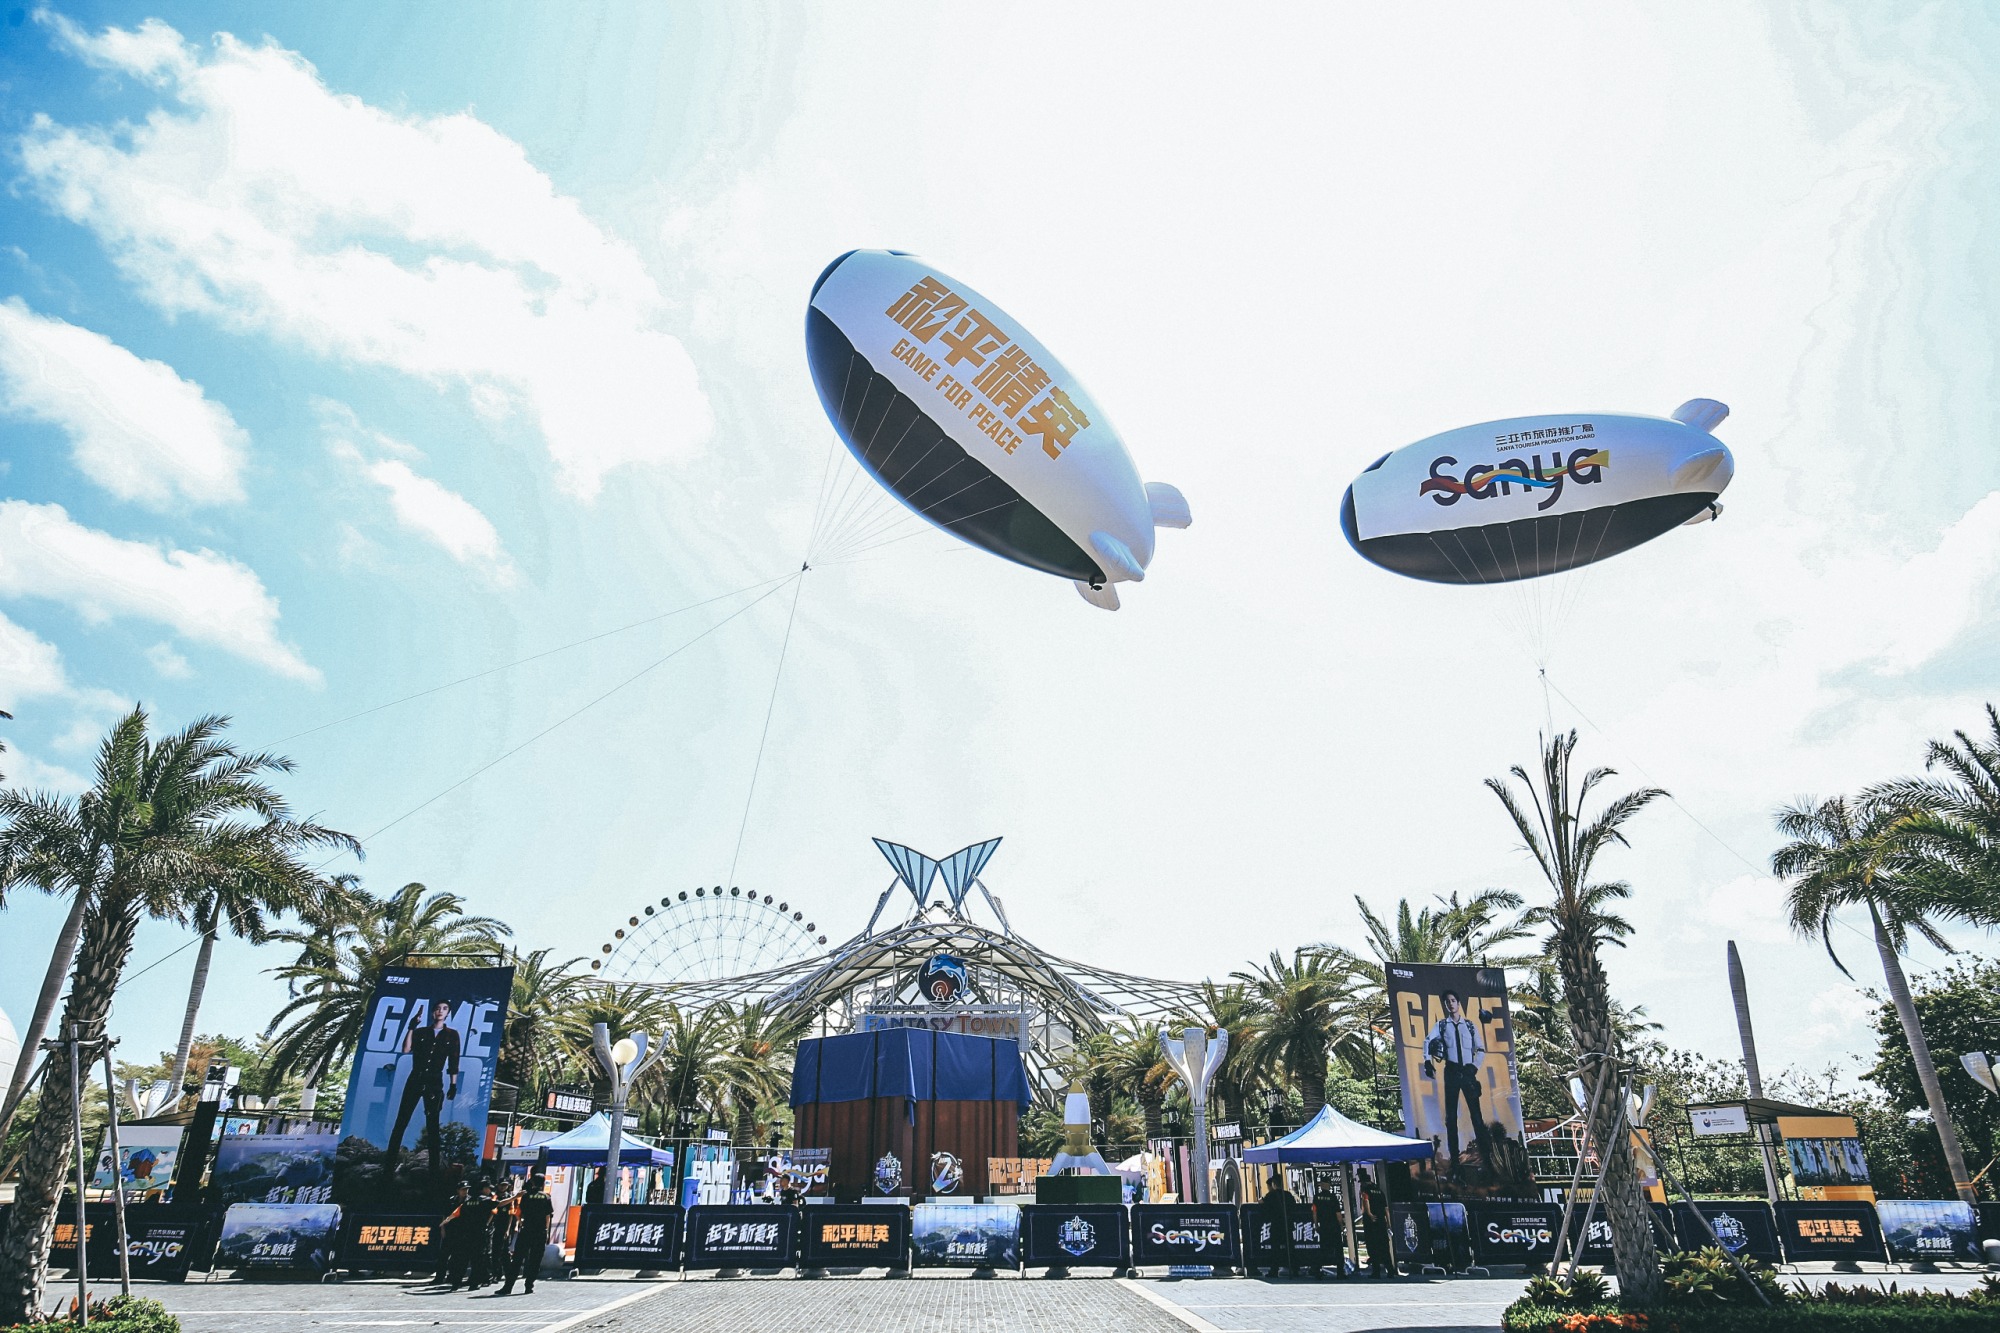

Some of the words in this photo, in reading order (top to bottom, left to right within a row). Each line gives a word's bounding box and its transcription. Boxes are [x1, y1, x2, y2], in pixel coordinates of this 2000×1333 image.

[885, 275, 1091, 461] 和平精英
[890, 337, 941, 382] GAME
[935, 373, 974, 411] FOR
[967, 402, 1023, 456] PEACE
[1495, 423, 1594, 446] 三亚市旅游推广局
[1515, 442, 1541, 450] TOURISM
[1541, 436, 1575, 446] PROMOTION
[1428, 447, 1602, 511] Sanya
[359, 1226, 431, 1245] 和平精英
[822, 1224, 890, 1243] 和平精英
[1151, 1222, 1222, 1252] Sanya
[1487, 1222, 1550, 1251] Sanya
[1797, 1219, 1863, 1237] 和平精英
